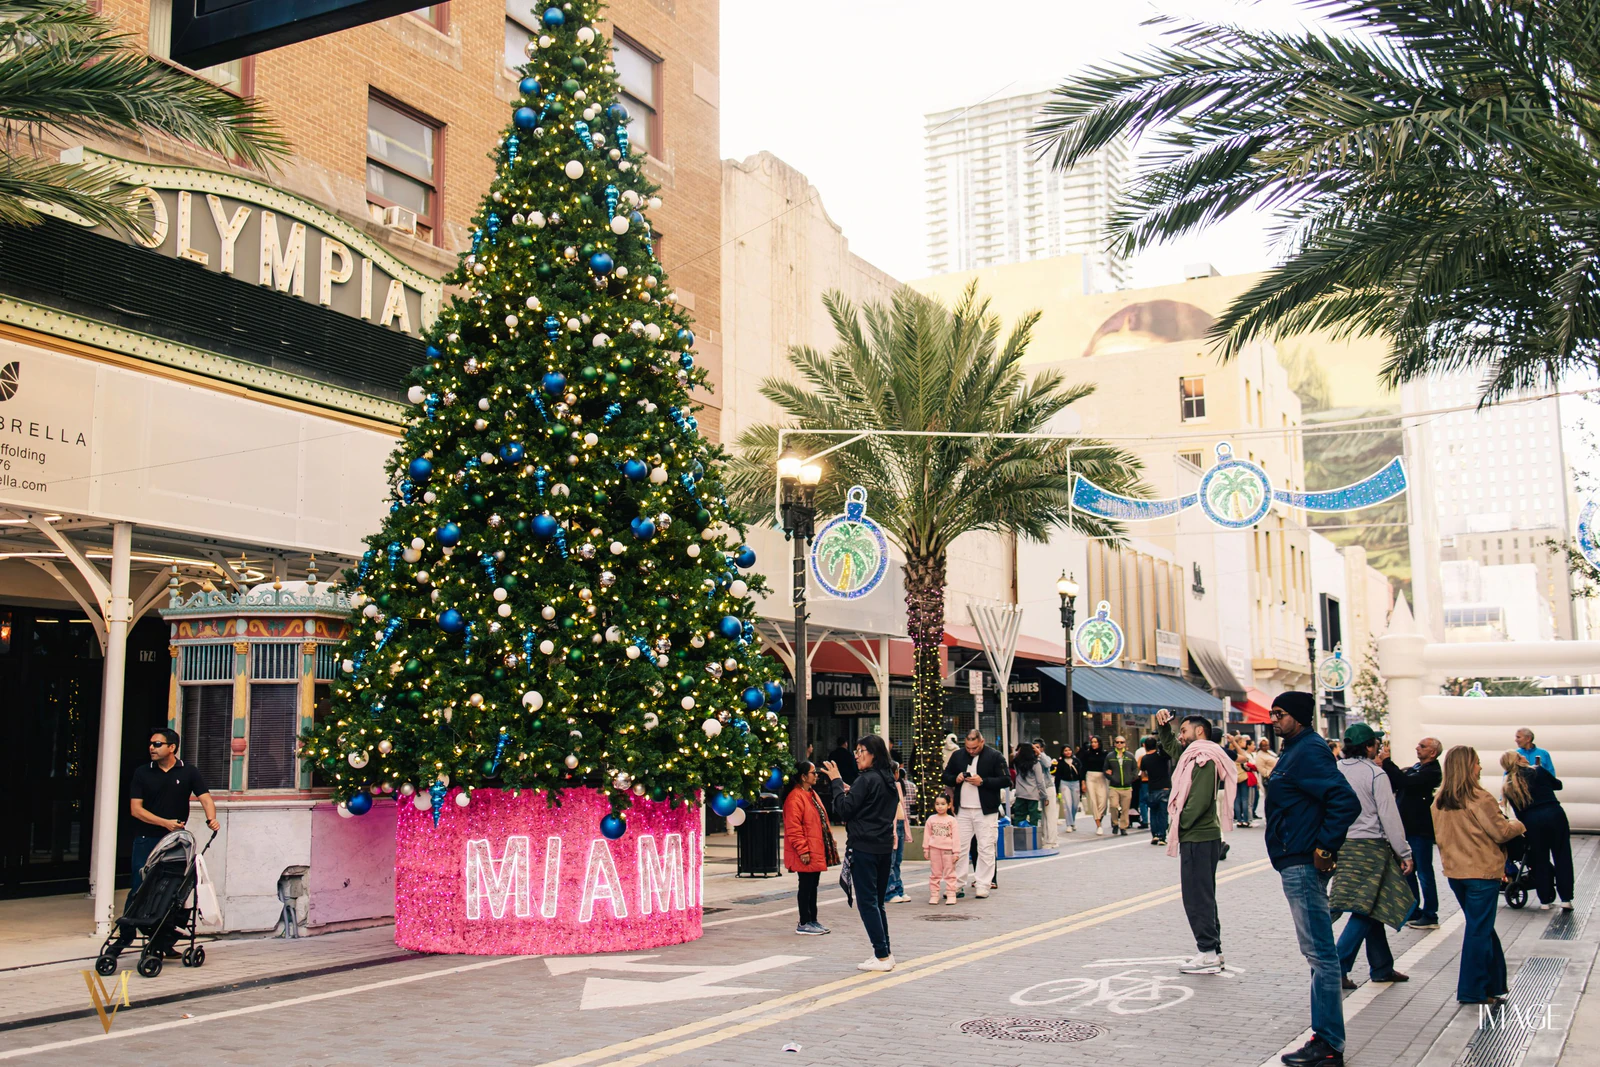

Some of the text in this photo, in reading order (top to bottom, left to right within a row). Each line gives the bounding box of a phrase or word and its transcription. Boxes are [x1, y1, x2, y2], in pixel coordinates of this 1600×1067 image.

[128, 186, 411, 333] OLYMPIA
[140, 650, 156, 662] 174
[816, 681, 863, 697] OPTICAL
[466, 831, 696, 922] MIAMI
